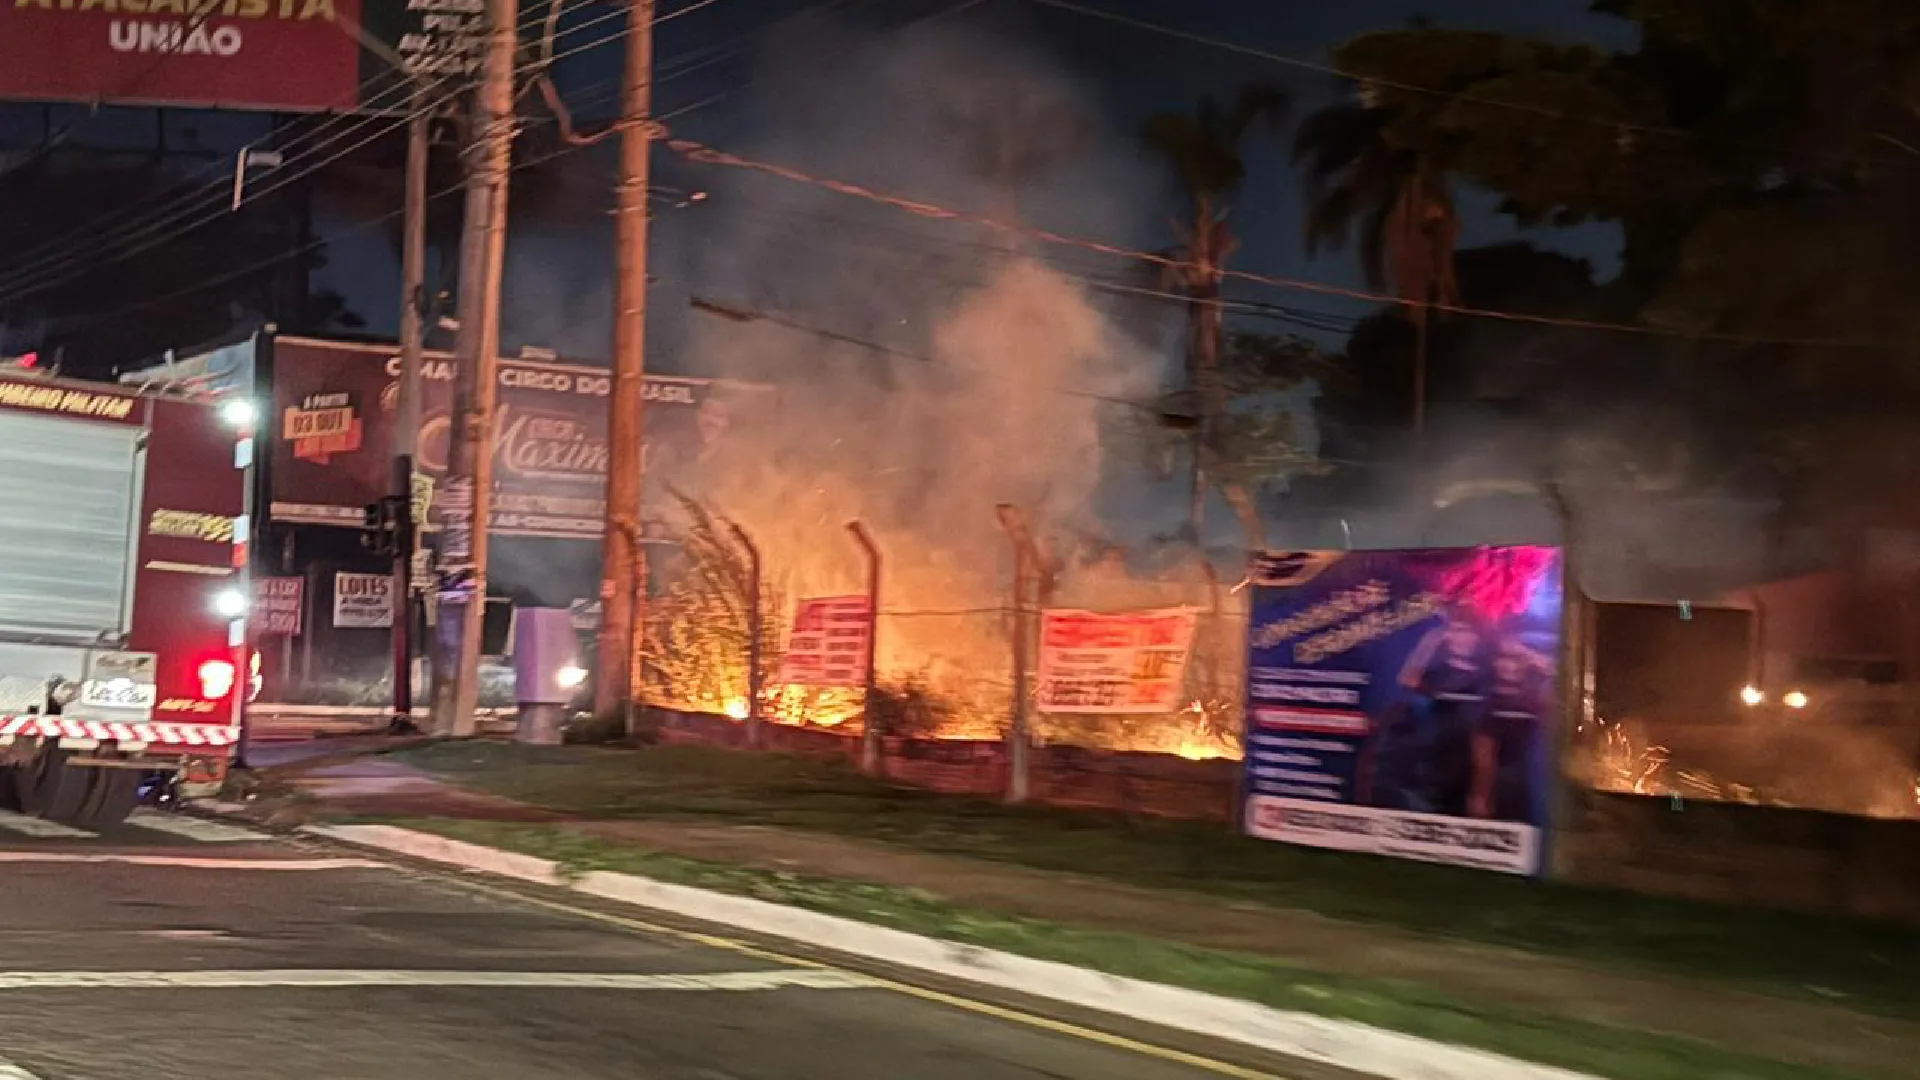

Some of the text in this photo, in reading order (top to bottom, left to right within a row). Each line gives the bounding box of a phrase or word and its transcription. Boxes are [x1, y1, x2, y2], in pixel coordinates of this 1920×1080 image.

[109, 20, 242, 55] UNIÃO
[500, 368, 572, 392] CIRCO
[576, 375, 611, 396] DO
[487, 402, 648, 474] Maxim
[338, 576, 389, 596] LOTES
